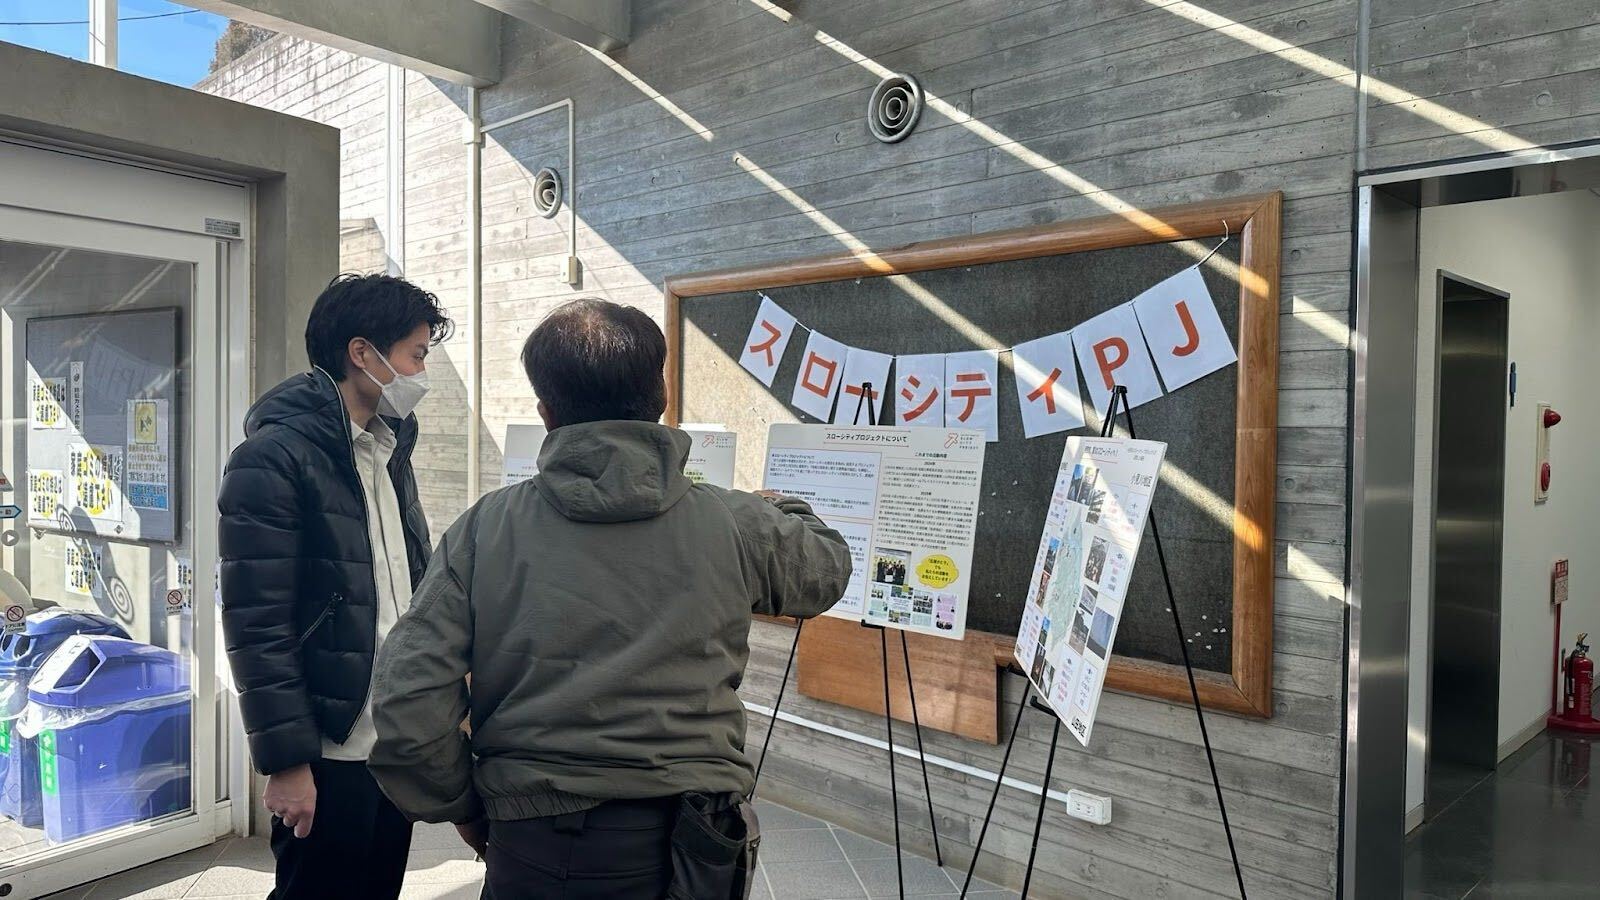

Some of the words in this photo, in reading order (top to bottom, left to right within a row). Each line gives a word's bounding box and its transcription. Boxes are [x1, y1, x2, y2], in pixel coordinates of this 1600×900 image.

[826, 433, 908, 443] スローシティプロジェクトについて
